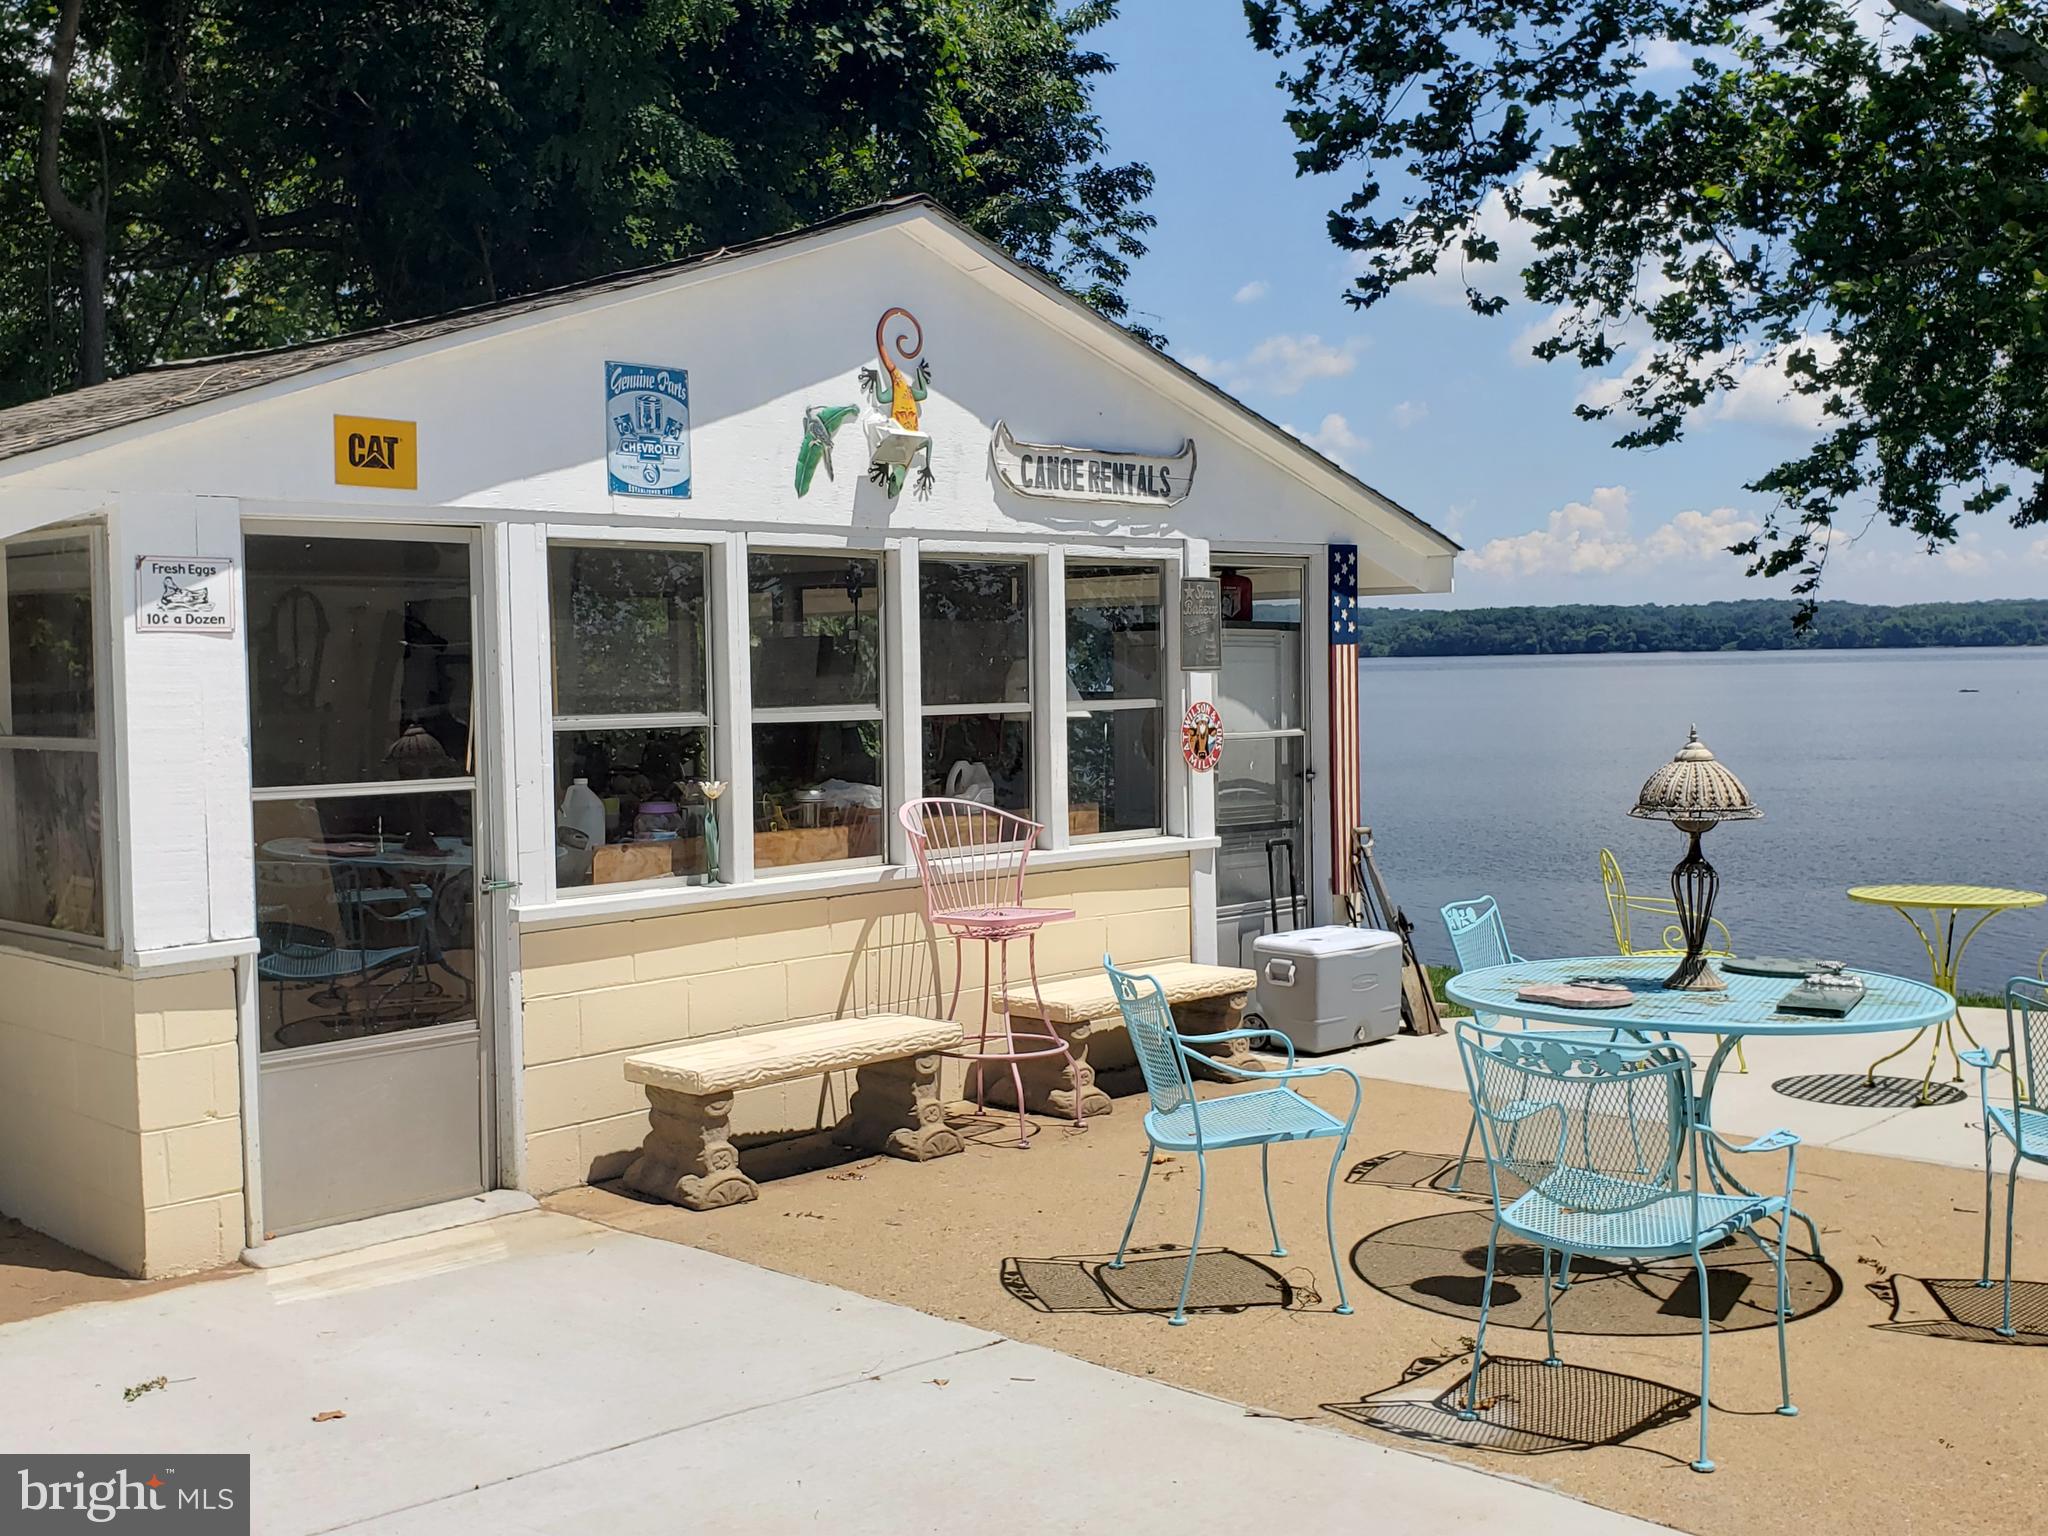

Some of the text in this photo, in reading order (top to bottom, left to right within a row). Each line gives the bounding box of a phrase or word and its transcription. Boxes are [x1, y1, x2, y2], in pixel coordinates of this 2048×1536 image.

[611, 367, 687, 400] Genuine Parts
[348, 433, 399, 470] CAT
[622, 441, 680, 456] CHEVROLET
[1021, 455, 1171, 498] CANOE RENTALS
[152, 563, 217, 577] Fresh Eggs
[146, 613, 226, 625] 10¢ a Dozen
[1184, 703, 1211, 728] WILSON
[1215, 721, 1223, 751] SONS
[1188, 754, 1217, 769] MILK
